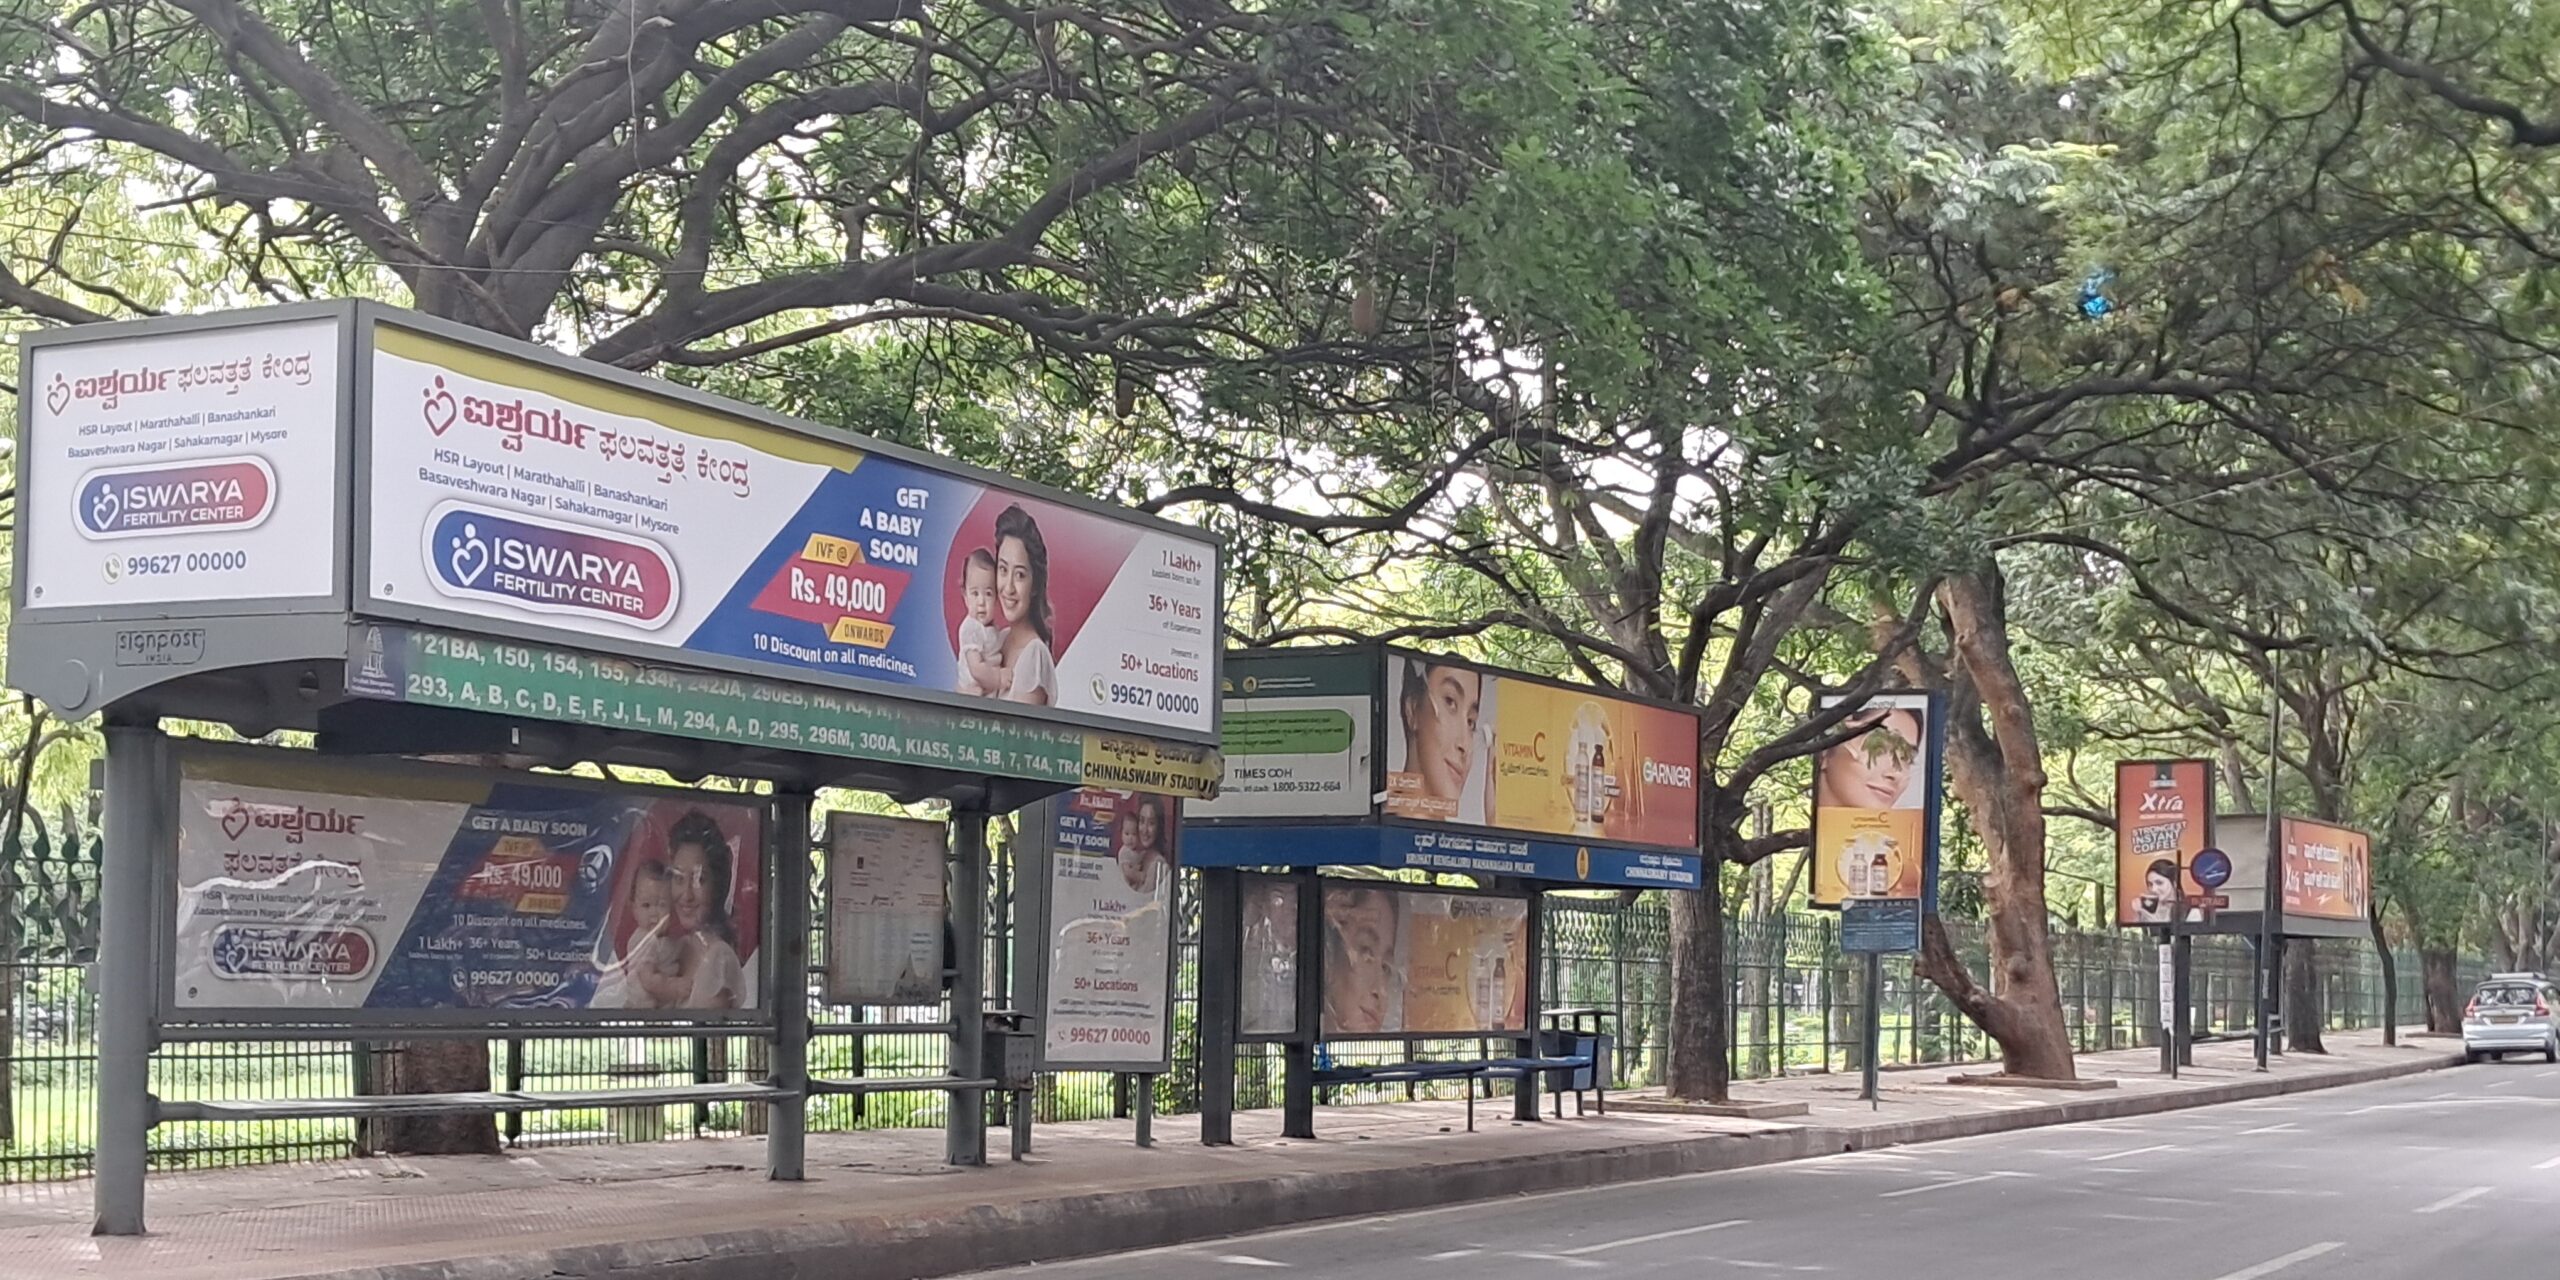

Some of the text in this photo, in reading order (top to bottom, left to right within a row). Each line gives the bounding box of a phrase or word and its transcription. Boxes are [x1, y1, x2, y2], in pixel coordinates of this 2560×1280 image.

[74, 350, 312, 411] ಐಶ್ವರ್ಯ ಫಲವತ್ತತೆ ಕೇಂದ್ರ
[78, 405, 276, 436] HSR Layout Marathahalli Banashankari
[67, 429, 288, 459] Basaveshwara Nagar Sahakarnagar Mysore
[462, 394, 596, 452] ಐಶ್ವರ್ಯ
[697, 448, 751, 499] ಕೇಂದ್ರ
[433, 448, 668, 512] HSR Layout Marathahalli Banashankari
[123, 479, 244, 511] ISWARYA
[418, 467, 680, 535] Basaveshwara Nagar Sahakarnagar Mysore
[896, 488, 929, 510] GET
[122, 504, 244, 527] FERTILITY CENTER
[860, 508, 923, 538] A BABY
[127, 550, 247, 575] 99627 00000
[814, 540, 848, 563] IVF @
[869, 538, 918, 566] SOON
[1161, 549, 1202, 573] 1 Lakh+
[493, 536, 645, 593] ISWARYA
[492, 571, 644, 614] FERTILITY CENTER
[790, 566, 886, 614] Rs. 49,000
[1148, 593, 1202, 620] 36+ Years
[120, 631, 202, 653] signpost
[843, 623, 885, 644] ONWARDS
[411, 632, 486, 666] 121BA,
[492, 645, 536, 673] 150,
[542, 651, 583, 680] 154,
[590, 661, 630, 686] 155,
[753, 633, 917, 678] 10 Discount on all medicines.
[1120, 653, 1199, 682] 50+ Locations
[1111, 683, 1200, 715] 99627 00000
[408, 673, 454, 703] 293,
[460, 681, 481, 706] A,
[488, 684, 509, 710] B,
[516, 688, 536, 714] C,
[543, 692, 562, 717] D,
[568, 695, 586, 720] E,
[592, 698, 607, 722] F,
[613, 701, 630, 724] J,
[635, 704, 652, 727] L,
[658, 707, 678, 731] M,
[683, 710, 720, 736] 294,
[725, 715, 743, 738] A,
[748, 718, 764, 740] D,
[769, 720, 804, 746] 295,
[808, 725, 855, 750] 296M,
[957, 745, 980, 767] 5A,
[983, 748, 1006, 770] 5B,
[1008, 751, 1021, 771] 7,
[1023, 754, 1052, 775] T4A,
[1056, 758, 1081, 776] TR4
[1533, 730, 1546, 763] C
[1083, 761, 1168, 788] CHINNASWAMY
[1234, 768, 1266, 779] TIMES
[2138, 792, 2184, 812] Xtra
[471, 816, 588, 837] GET A BABY SOON
[1060, 815, 1086, 829] GET A
[1059, 831, 1110, 848] BABY SOON
[2132, 829, 2180, 845] INSTANT
[2133, 840, 2178, 855] COFFEE
[511, 863, 562, 889] 49,000
[1093, 898, 1126, 911] 1 Lakh+
[453, 914, 464, 927] 10
[467, 914, 509, 928] Discount
[511, 917, 522, 928] on
[524, 915, 537, 928] all
[251, 940, 352, 960] ISWARYA
[418, 936, 521, 951] 1 Lakh+ 36+ Years
[1086, 931, 1131, 946] 36+ Years
[309, 961, 351, 972] CENTER
[525, 949, 545, 960] 50+
[470, 971, 560, 987] 99627 00000
[1073, 977, 1139, 992] 50+ Locations
[1070, 1026, 1151, 1045] 99627 00000
